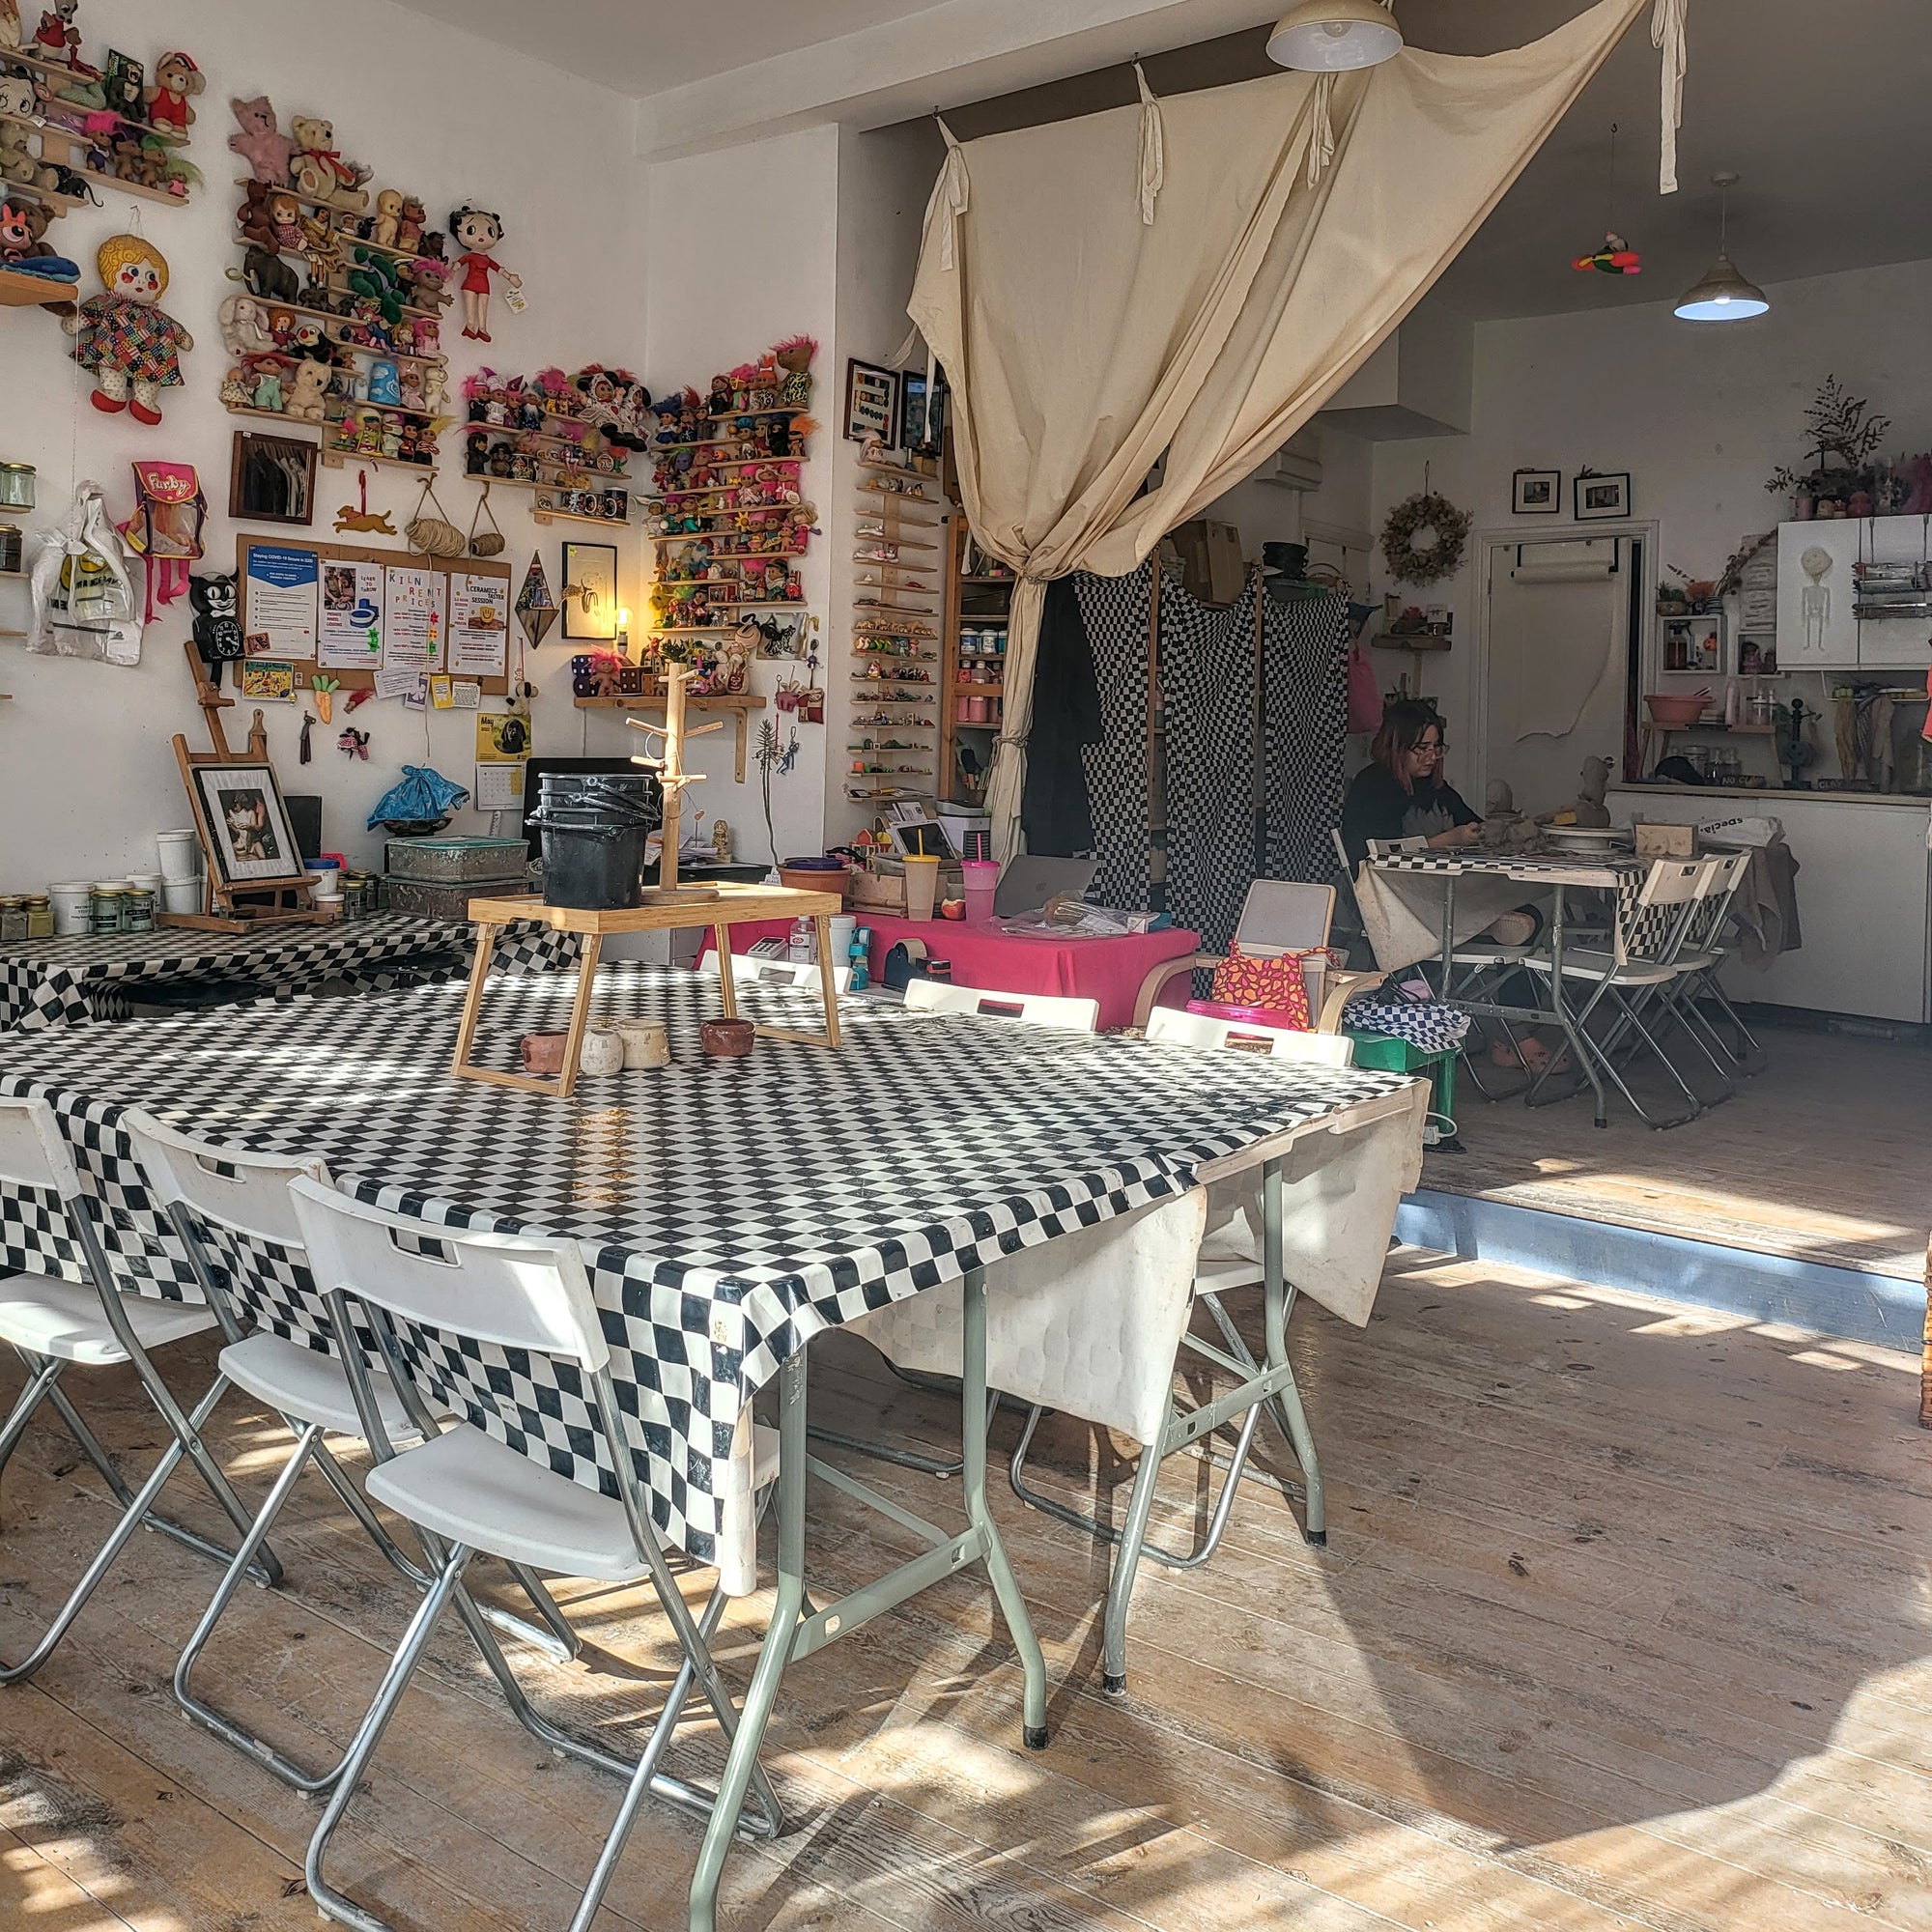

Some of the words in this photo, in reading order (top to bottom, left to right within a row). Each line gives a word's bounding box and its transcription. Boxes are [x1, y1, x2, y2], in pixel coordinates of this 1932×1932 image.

[148, 472, 190, 497] Furby
[389, 574, 421, 586] KILN
[409, 586, 441, 598] RENT
[469, 585, 497, 594] CERAMICS
[395, 594, 435, 609] PRICES
[471, 596, 494, 605] SESSION
[480, 716, 495, 727] May
[1721, 776, 1736, 785] NO
[1700, 817, 1743, 834] specia
